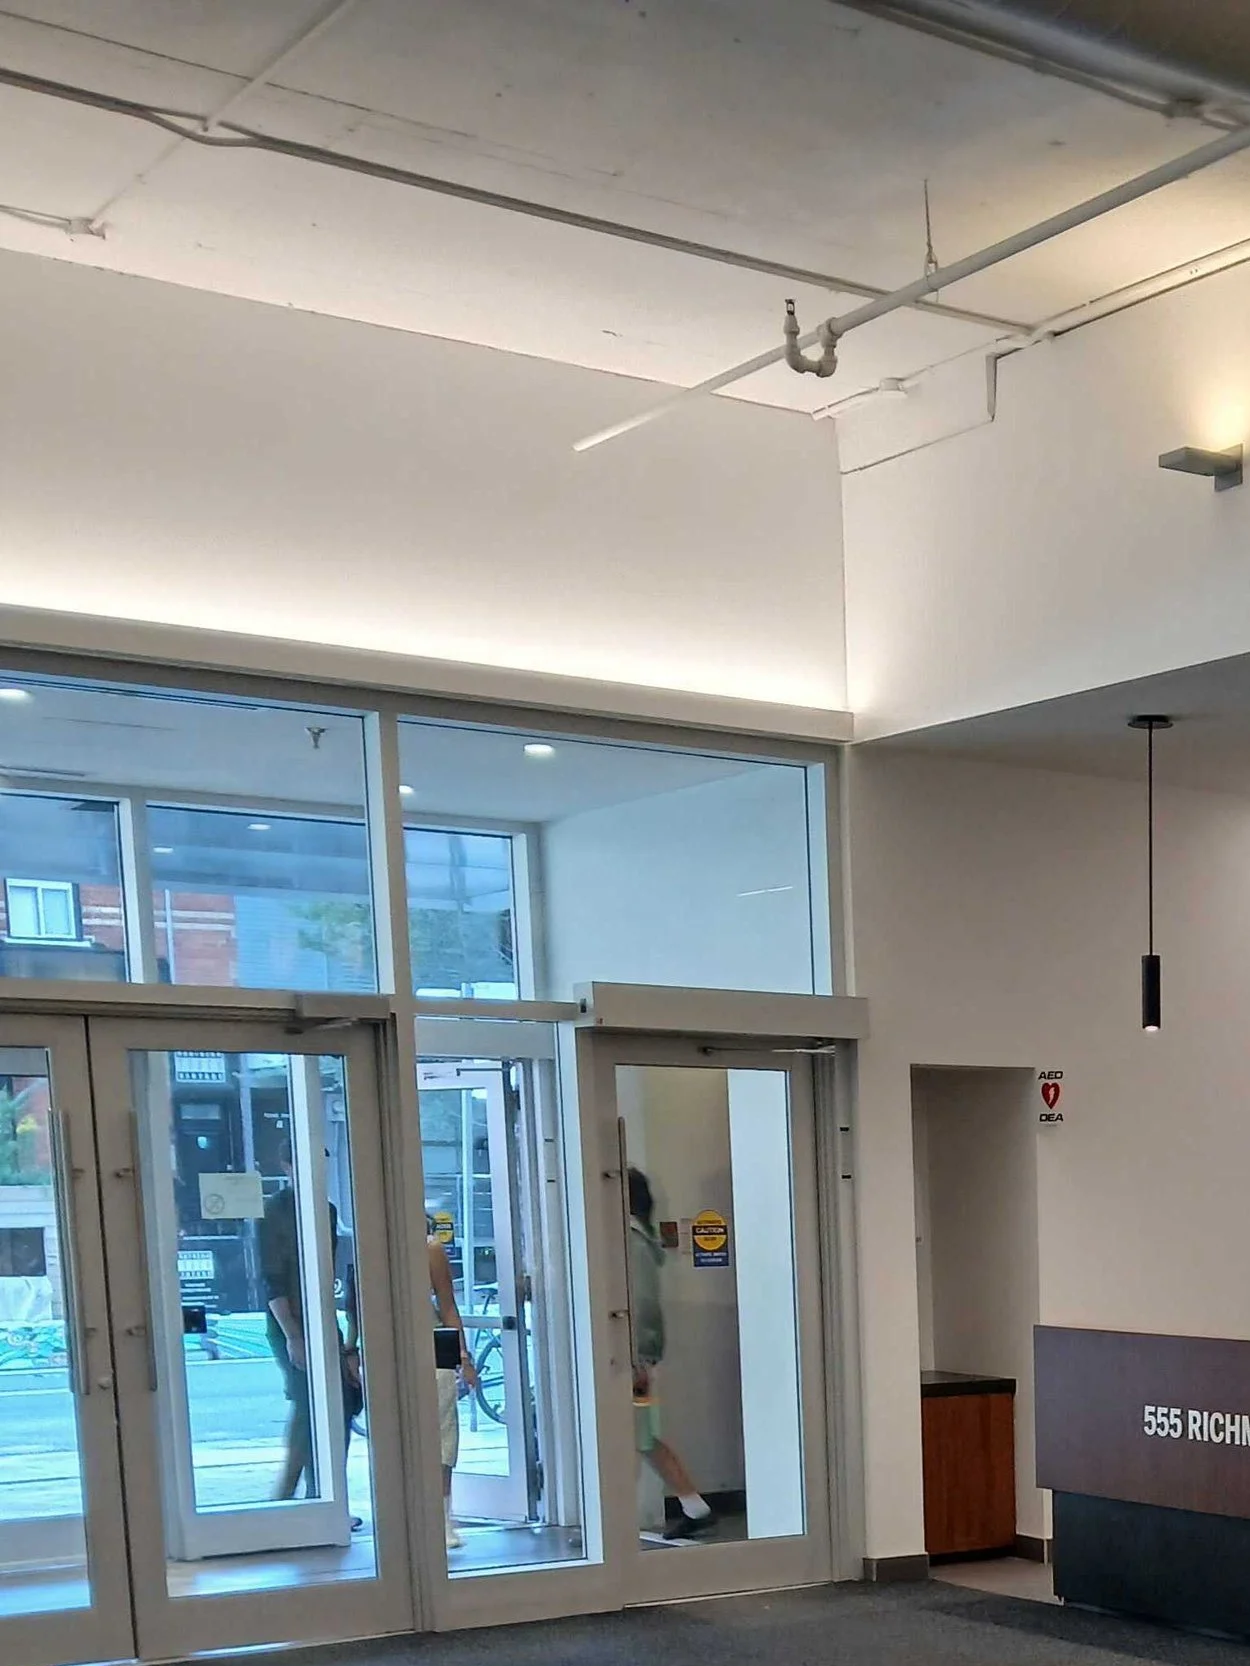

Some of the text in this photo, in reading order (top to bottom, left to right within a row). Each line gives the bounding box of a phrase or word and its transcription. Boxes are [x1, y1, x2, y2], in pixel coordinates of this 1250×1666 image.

[1038, 1070, 1063, 1080] AED
[1039, 1113, 1063, 1122] DEA
[1143, 1405, 1183, 1439] 555
